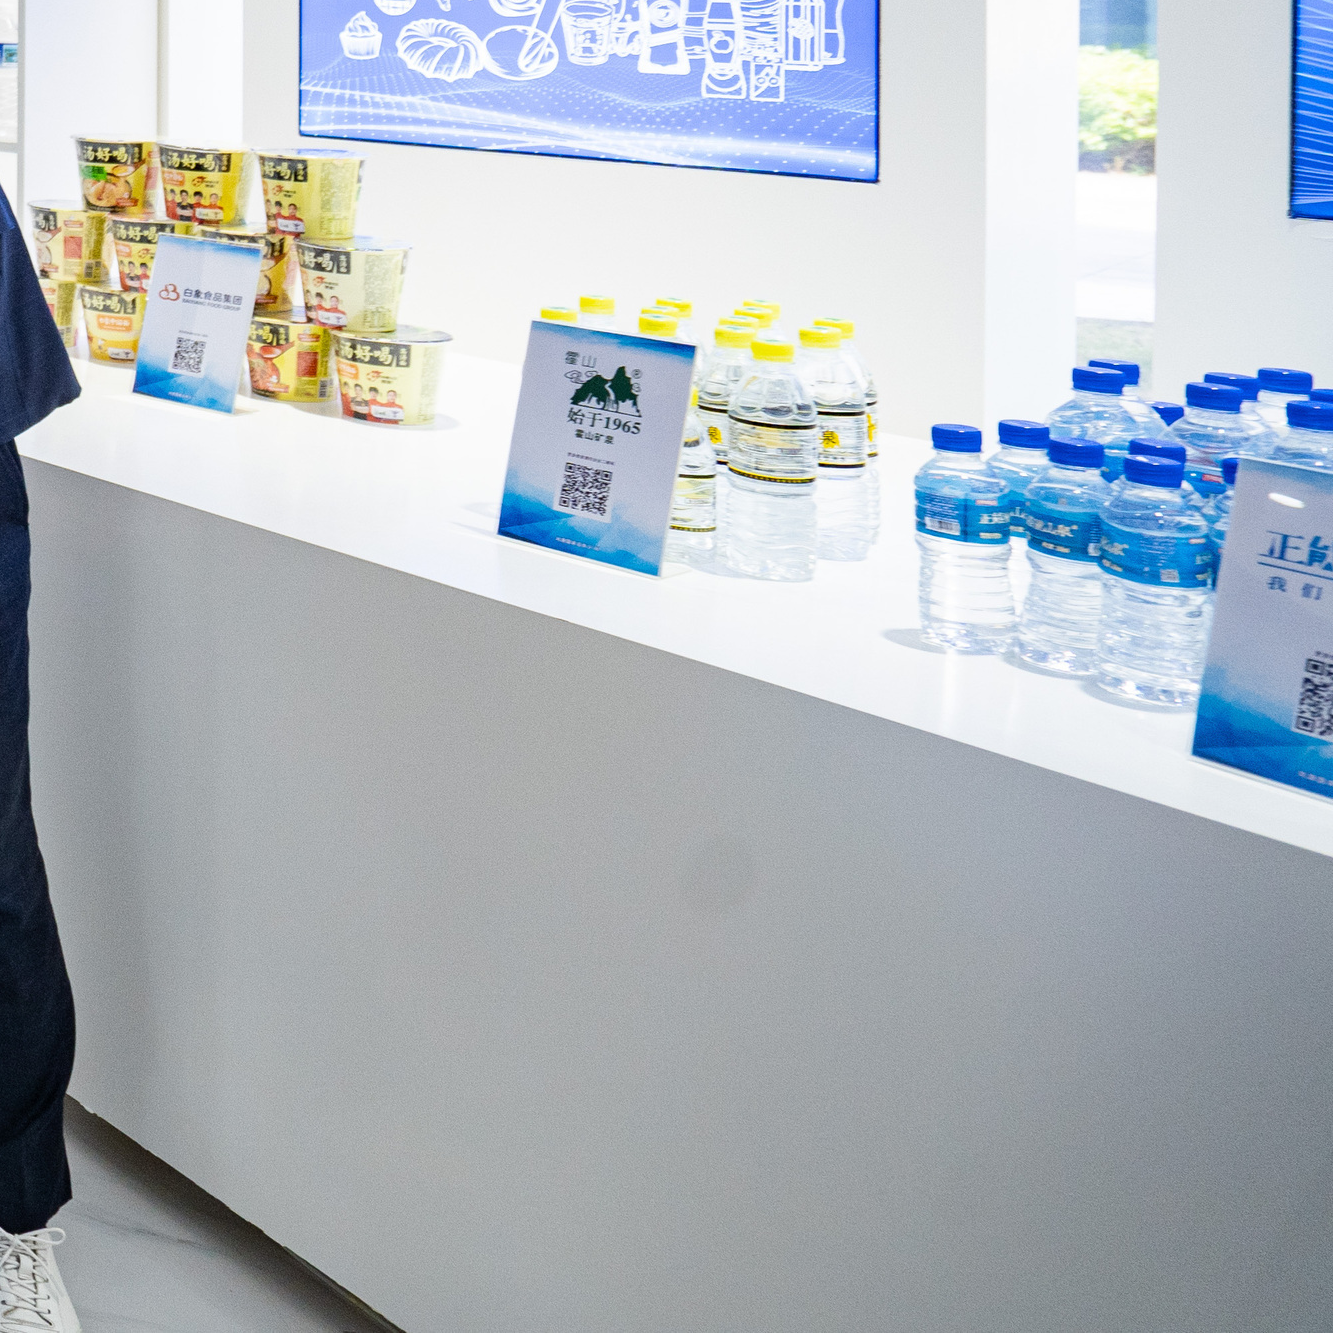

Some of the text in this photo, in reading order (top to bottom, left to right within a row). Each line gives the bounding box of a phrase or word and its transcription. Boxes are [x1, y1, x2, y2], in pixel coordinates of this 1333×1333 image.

[83, 145, 128, 163] 汤好喝
[167, 152, 216, 170] 汤好喝
[260, 160, 291, 180] 好喝
[299, 250, 333, 271] 好喝
[183, 288, 243, 306] 白象食品集团
[340, 341, 393, 365] 汤好喝
[567, 407, 642, 435] 始于1965
[574, 428, 615, 445] 霍山矿泉
[1266, 575, 1323, 601] 我们
